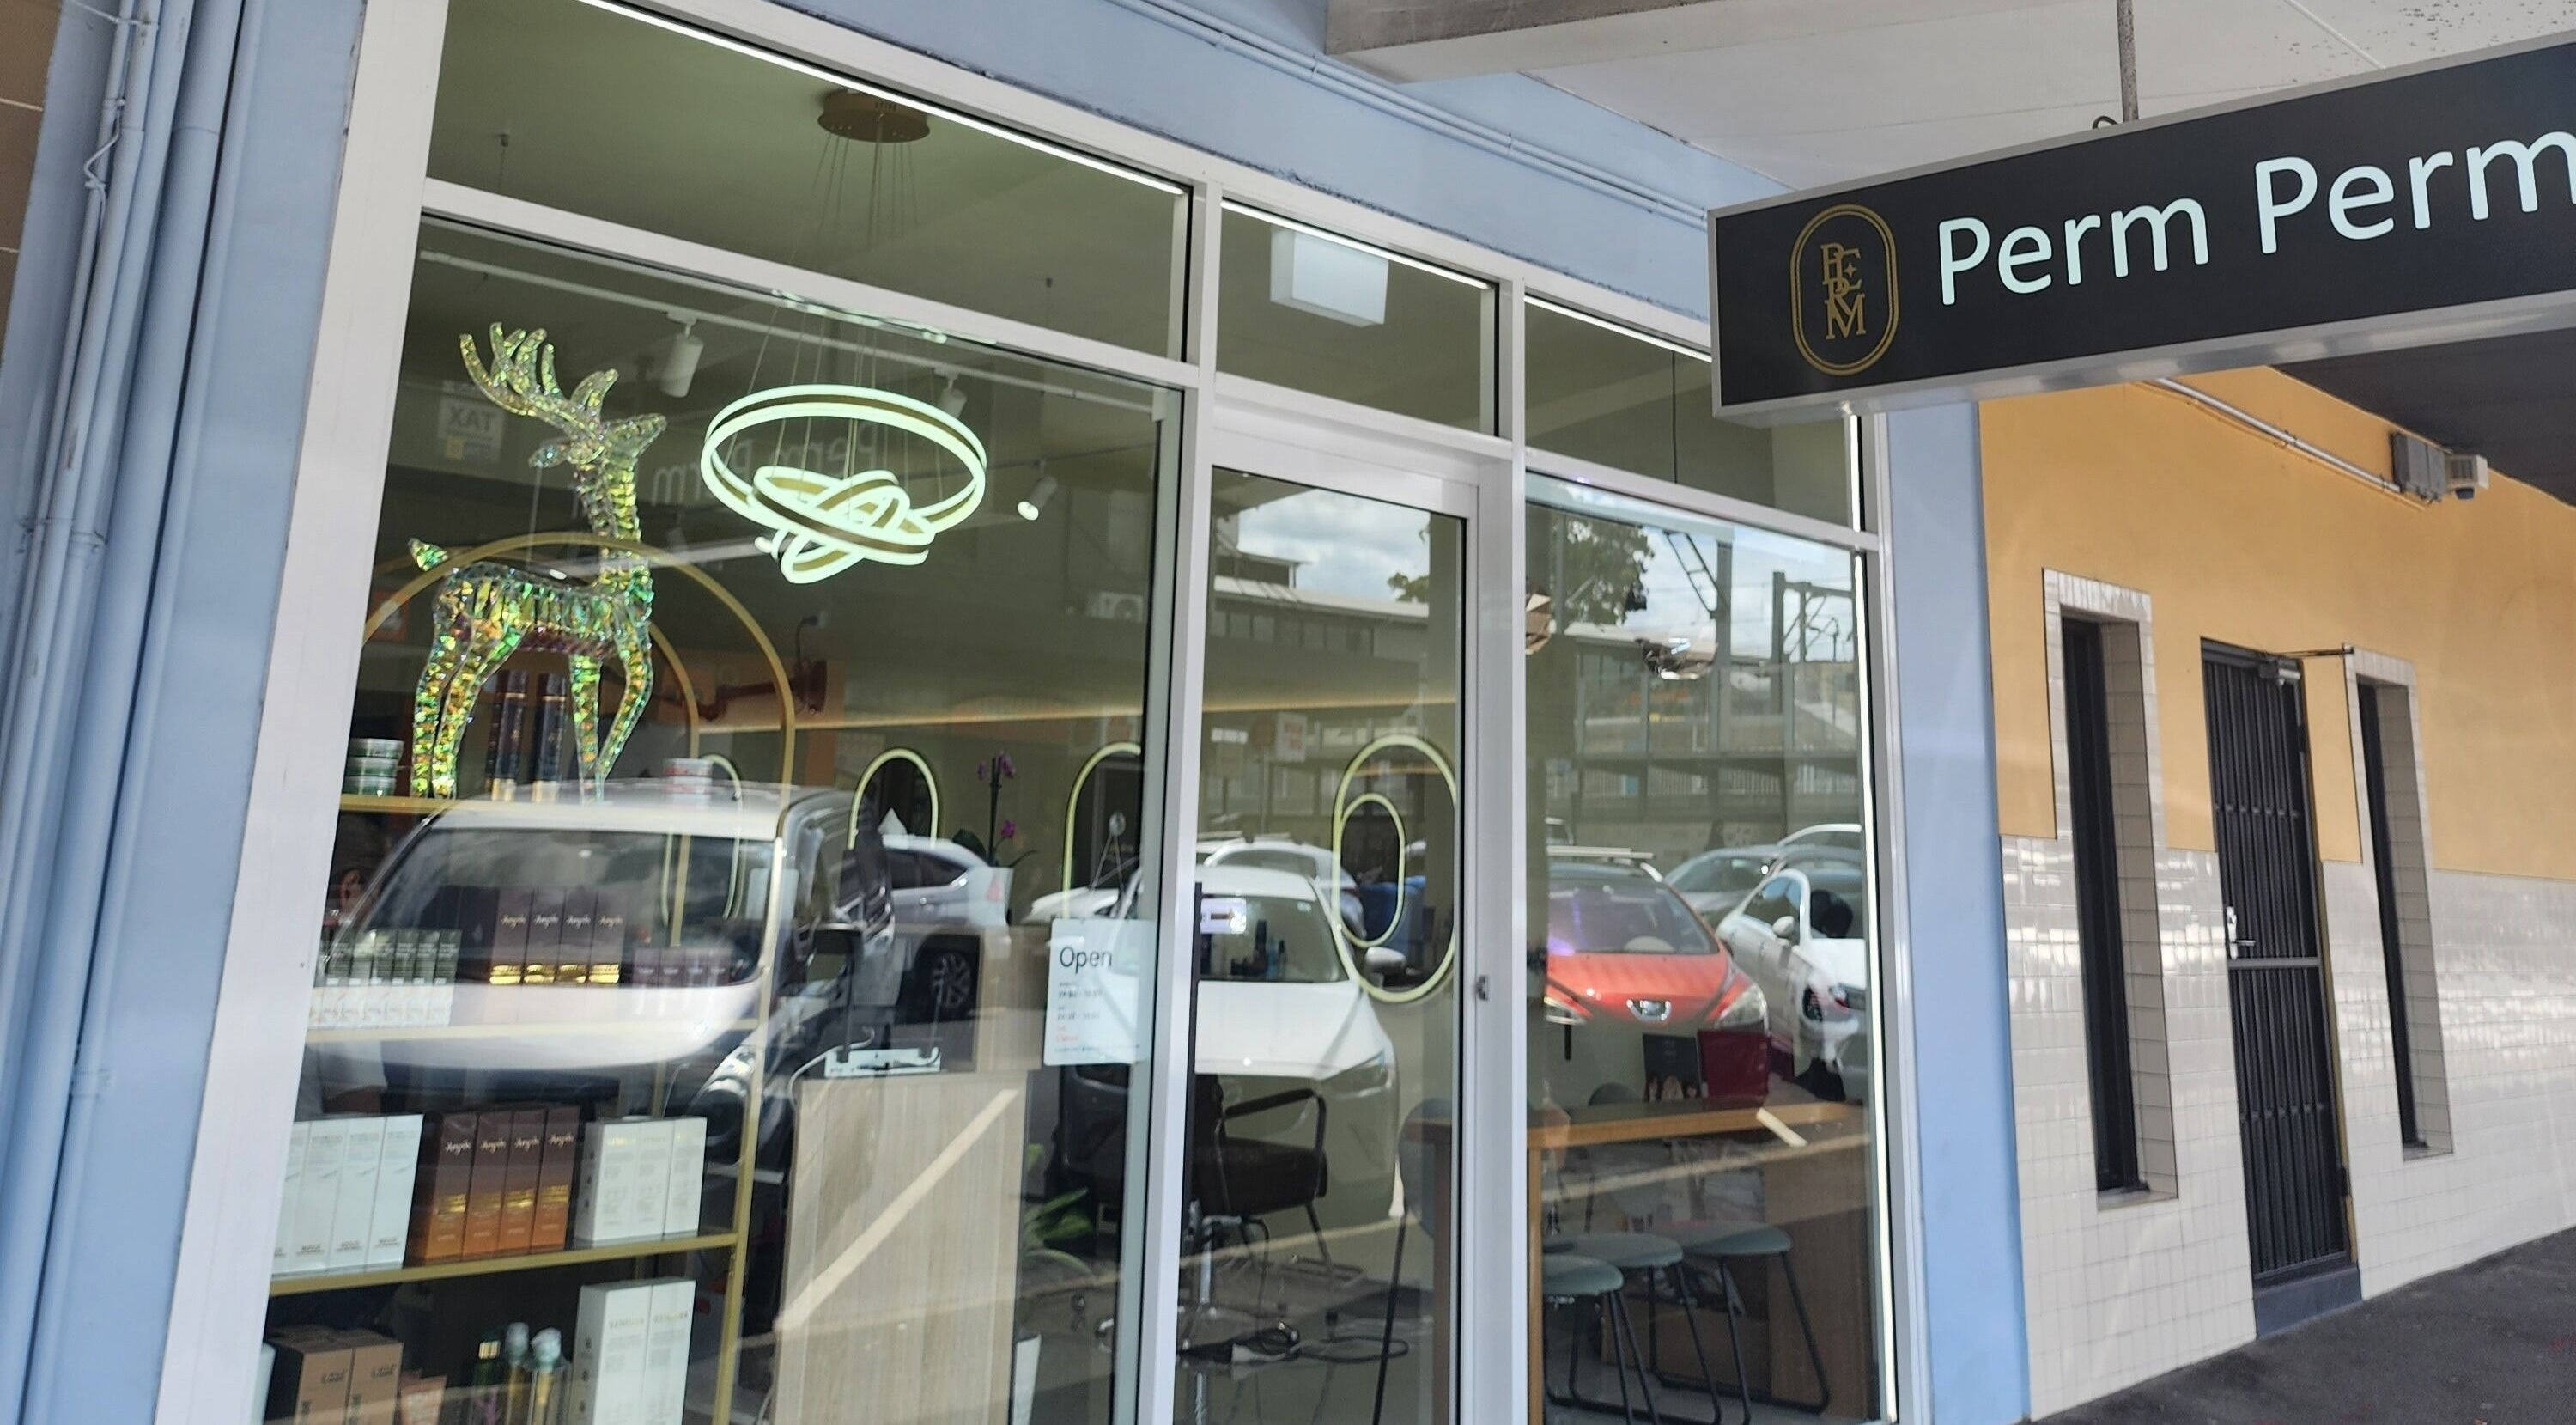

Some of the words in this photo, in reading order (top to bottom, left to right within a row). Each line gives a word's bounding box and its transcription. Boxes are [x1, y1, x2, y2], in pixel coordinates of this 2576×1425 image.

[1938, 198, 2209, 306] Perm
[2254, 131, 2576, 254] Perm
[1059, 946, 1113, 974] Open
